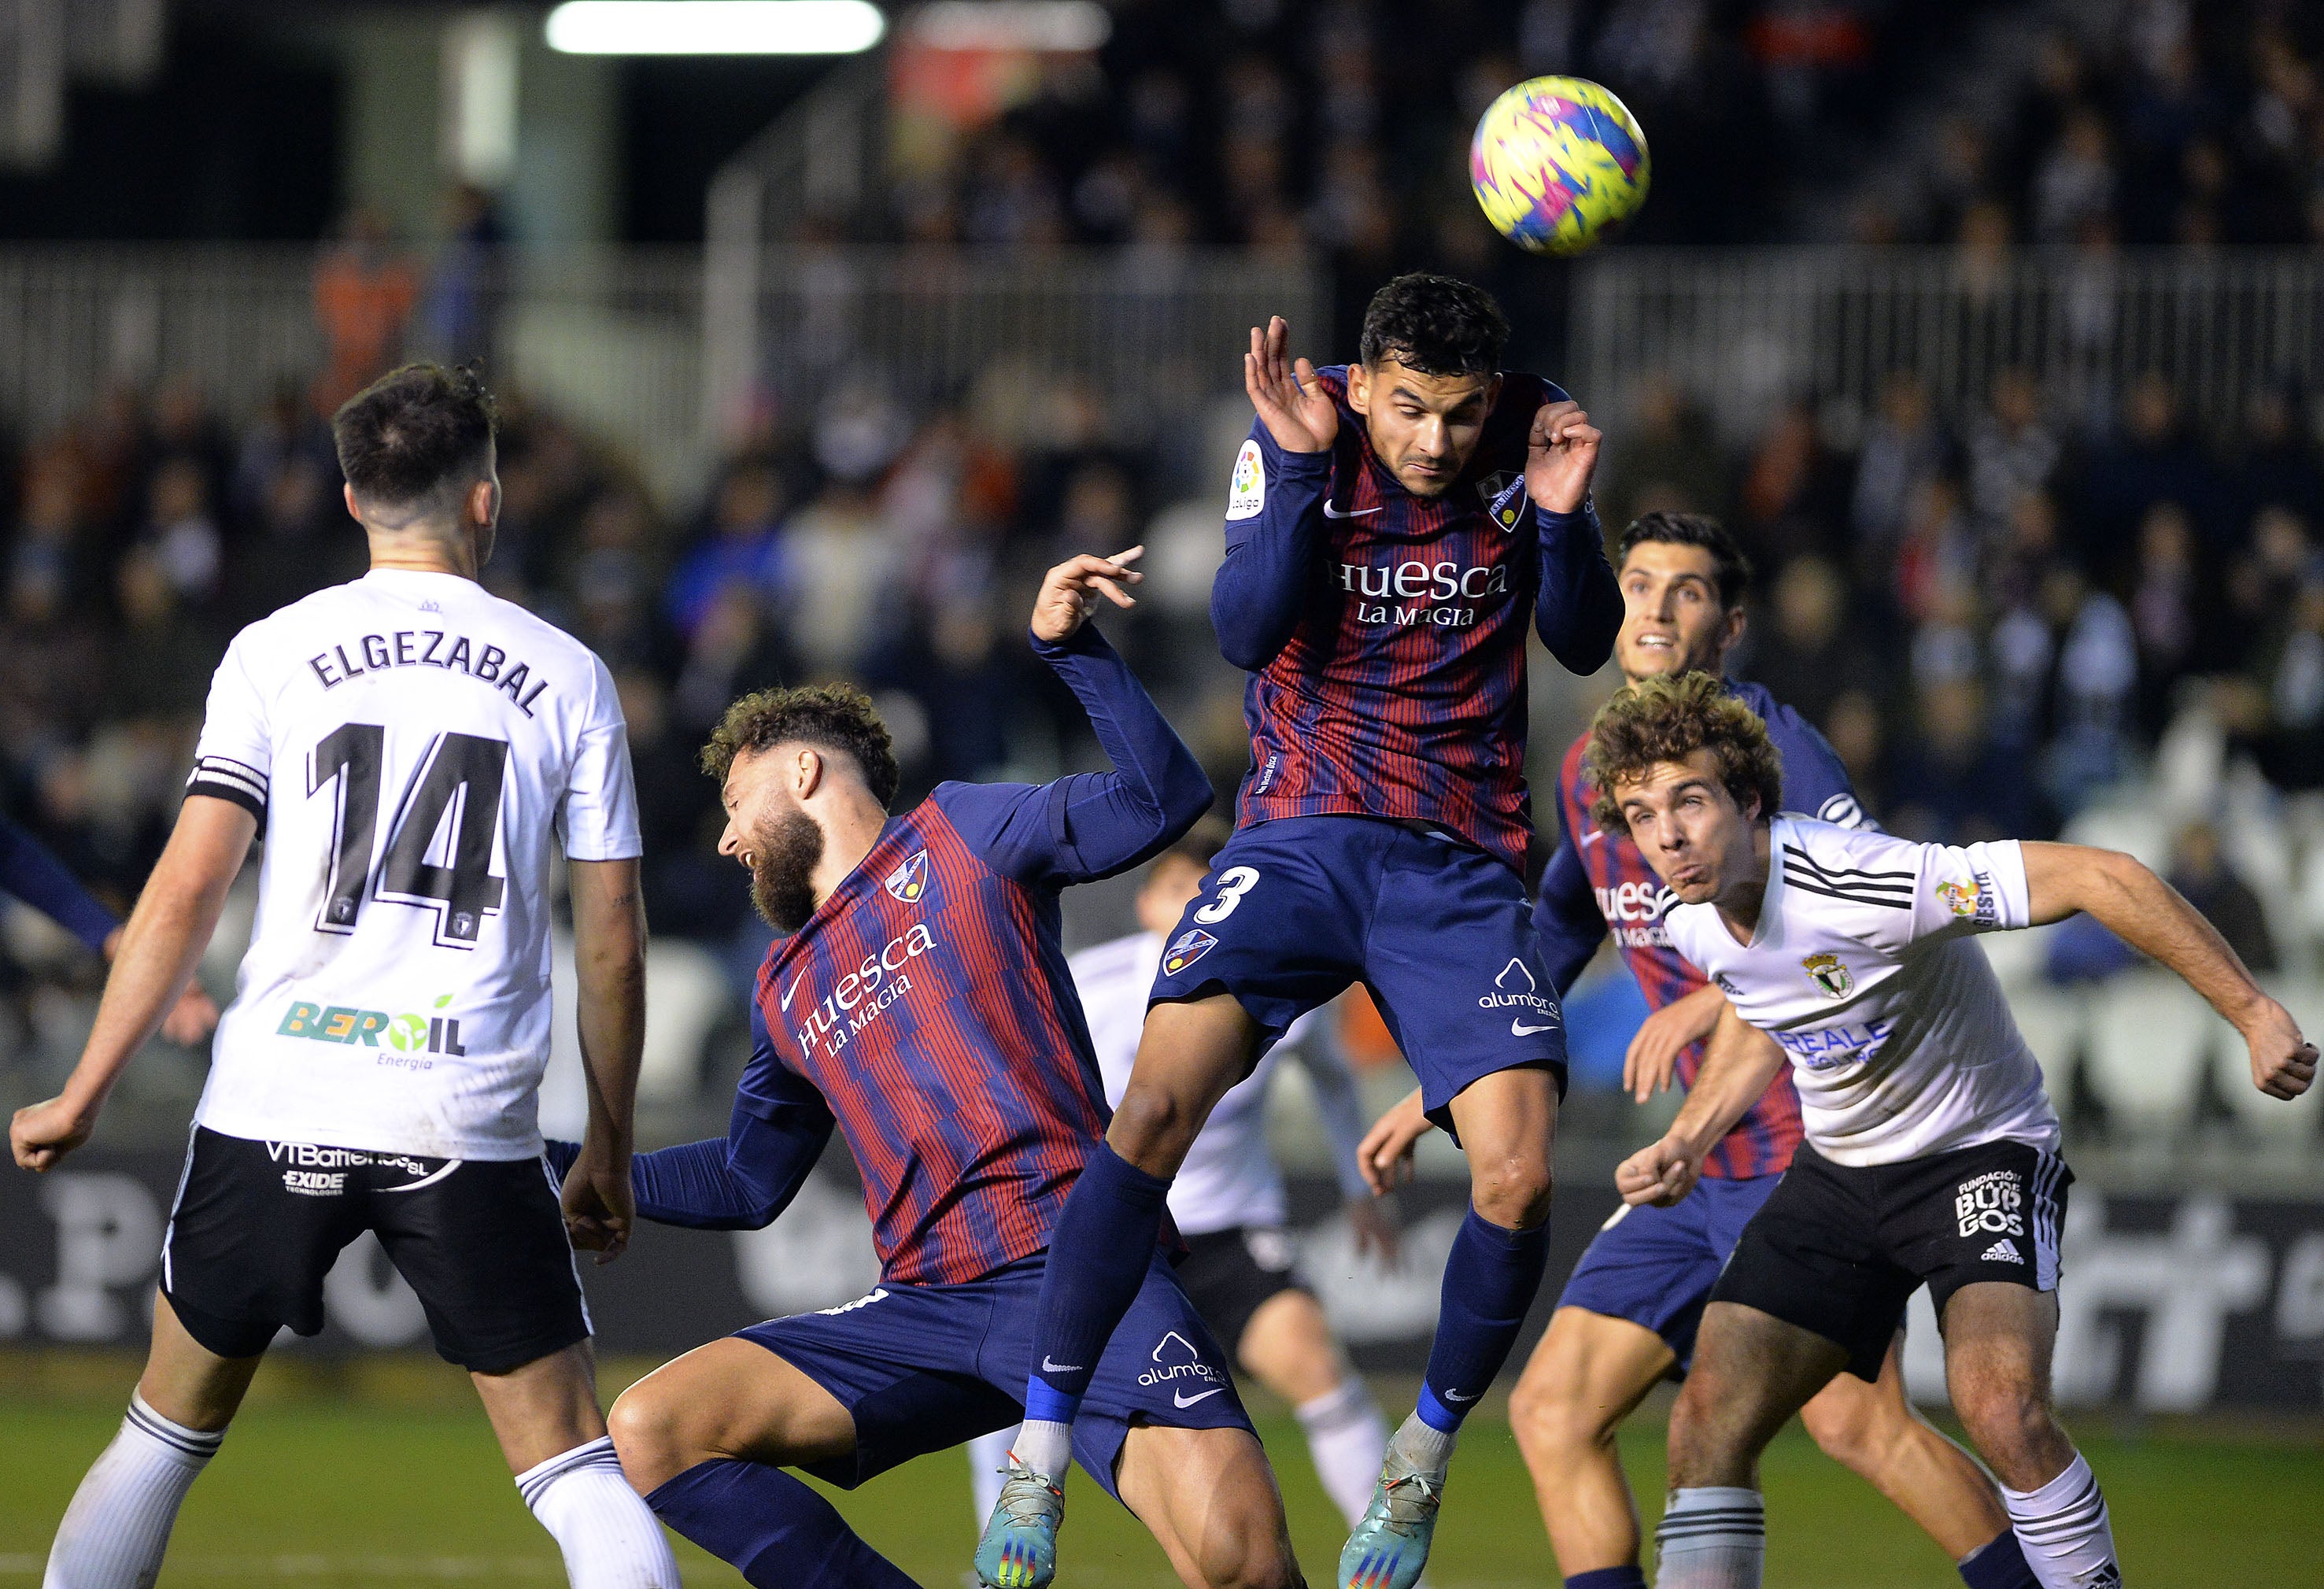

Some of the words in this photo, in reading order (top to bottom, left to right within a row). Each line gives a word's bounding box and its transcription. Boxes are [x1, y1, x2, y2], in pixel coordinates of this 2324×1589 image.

[1323, 559, 1508, 600] Huesca
[307, 630, 549, 719] ELGEZABAL
[306, 722, 509, 951] 14
[1193, 866, 1260, 924] 3
[797, 922, 937, 1060] Huesca
[1478, 991, 1558, 1014] alumbra
[275, 1000, 466, 1057] BEROIL
[1775, 1016, 1896, 1053] REALE
[283, 1170, 348, 1189] EXIDE
[406, 1162, 429, 1177] SL
[1958, 1170, 2023, 1195] FUNDACIÓN
[1958, 1209, 2024, 1238] GOS
[1980, 1252, 2025, 1266] adidas
[1137, 1360, 1227, 1387] alumbra
